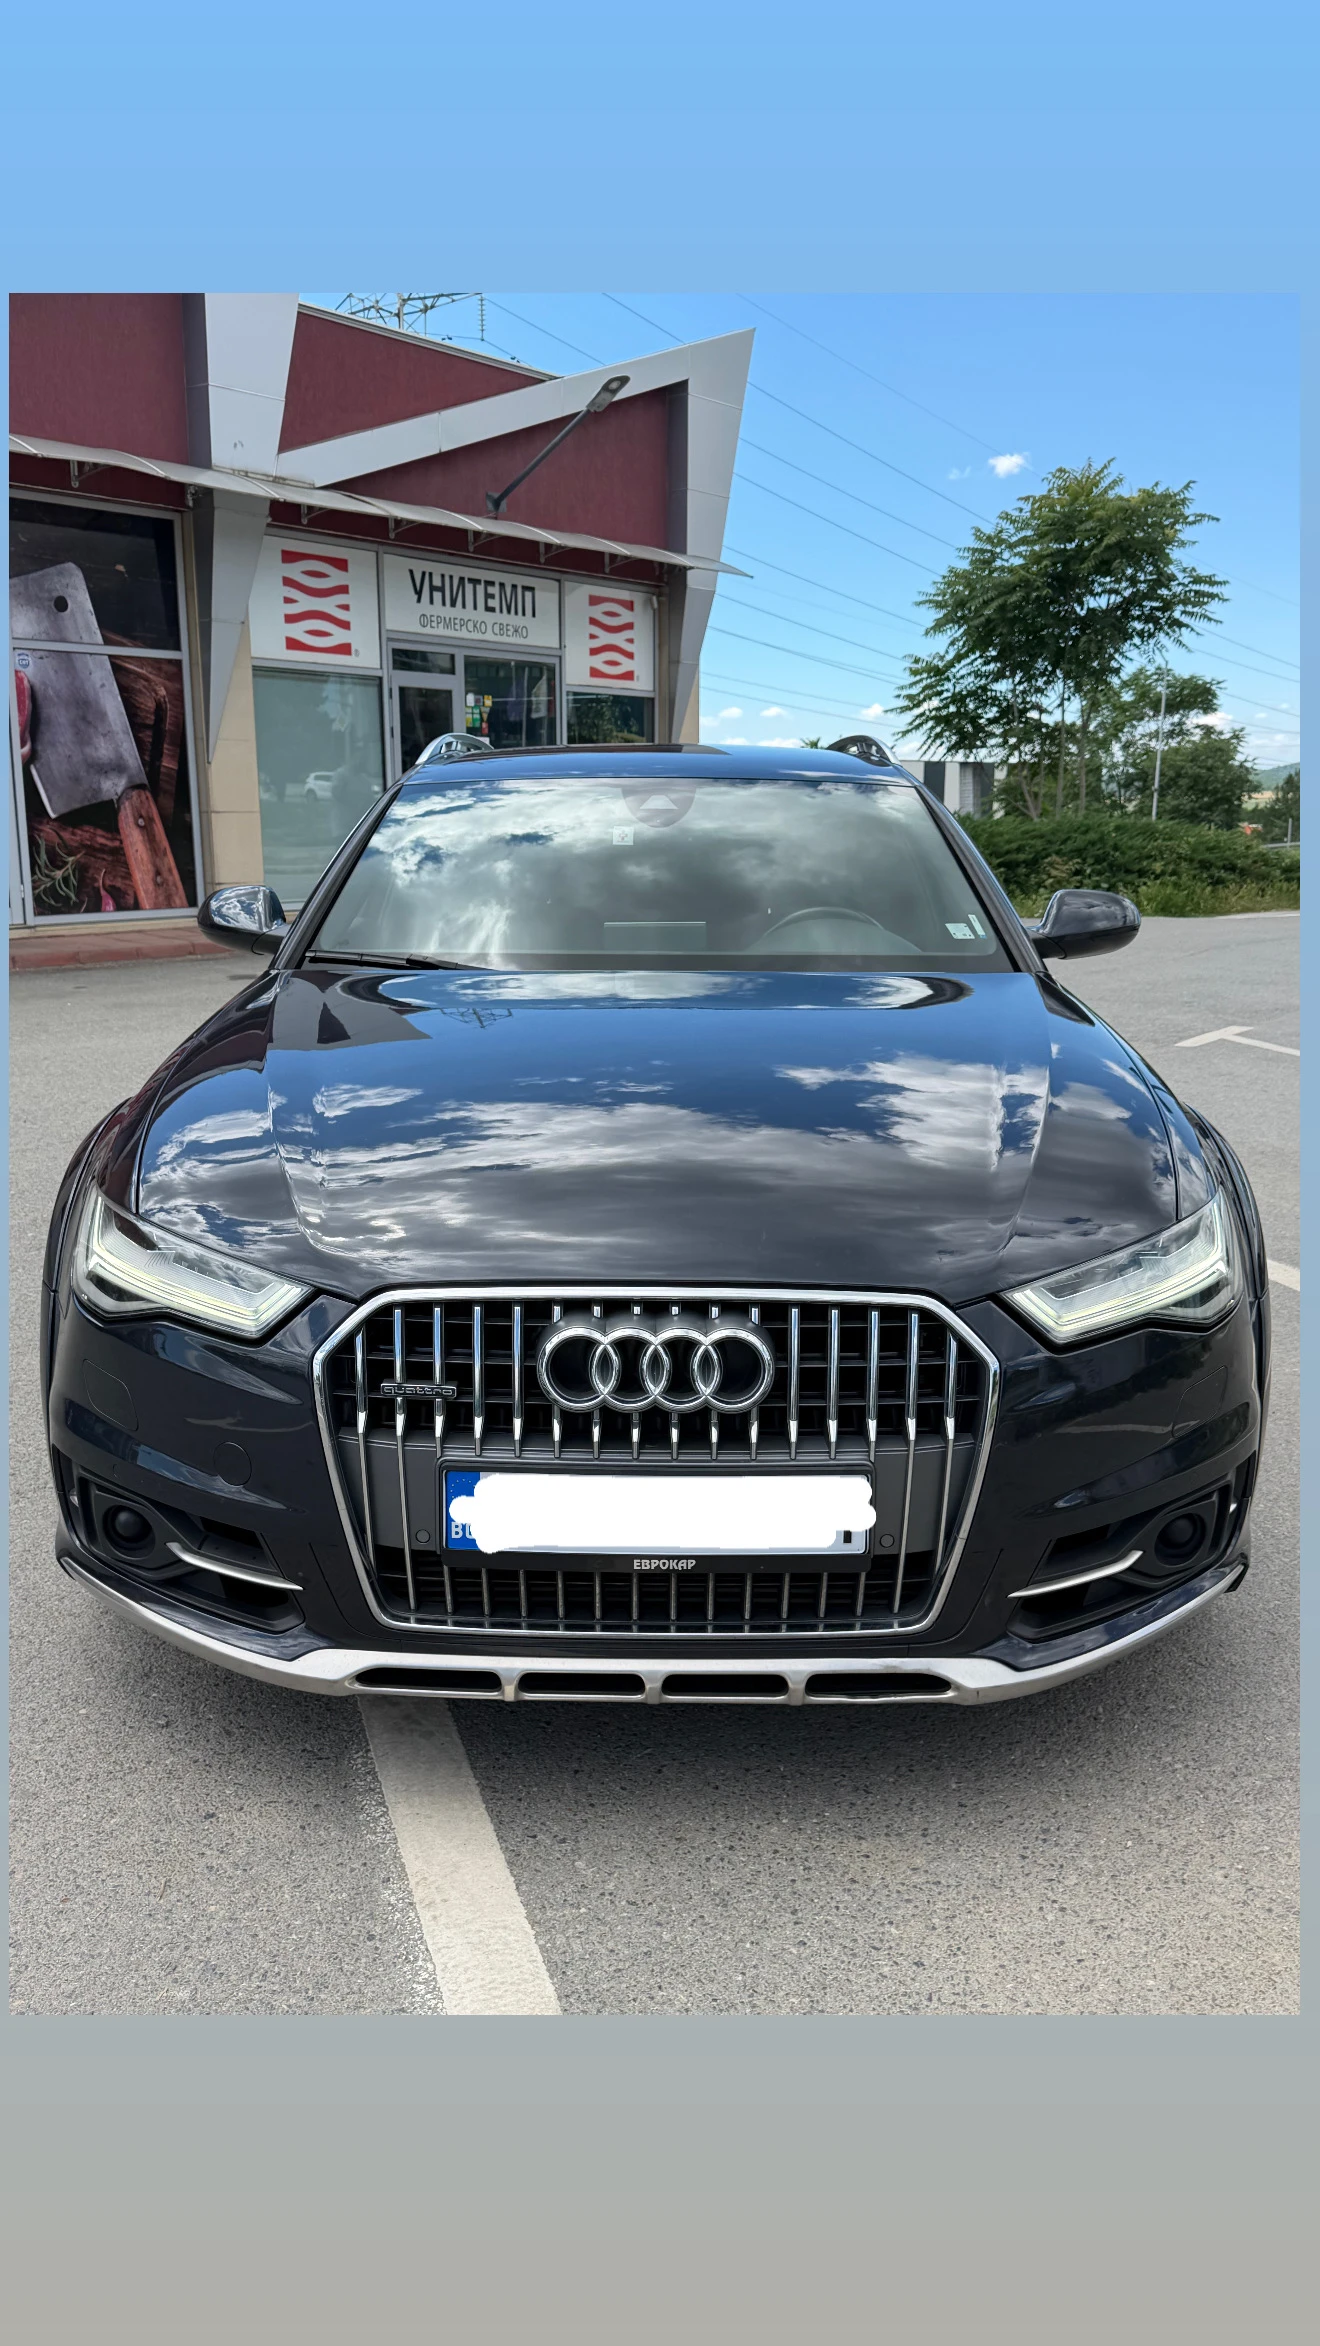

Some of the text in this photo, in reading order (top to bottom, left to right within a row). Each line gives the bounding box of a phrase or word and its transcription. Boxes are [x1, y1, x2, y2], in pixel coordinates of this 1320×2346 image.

[408, 568, 536, 618] УНИТЕМП
[419, 613, 529, 639] ФЕРМЕРСКО СВЕЖО
[383, 1386, 453, 1395] quattro
[633, 1559, 697, 1571] ЕВРОКАР
